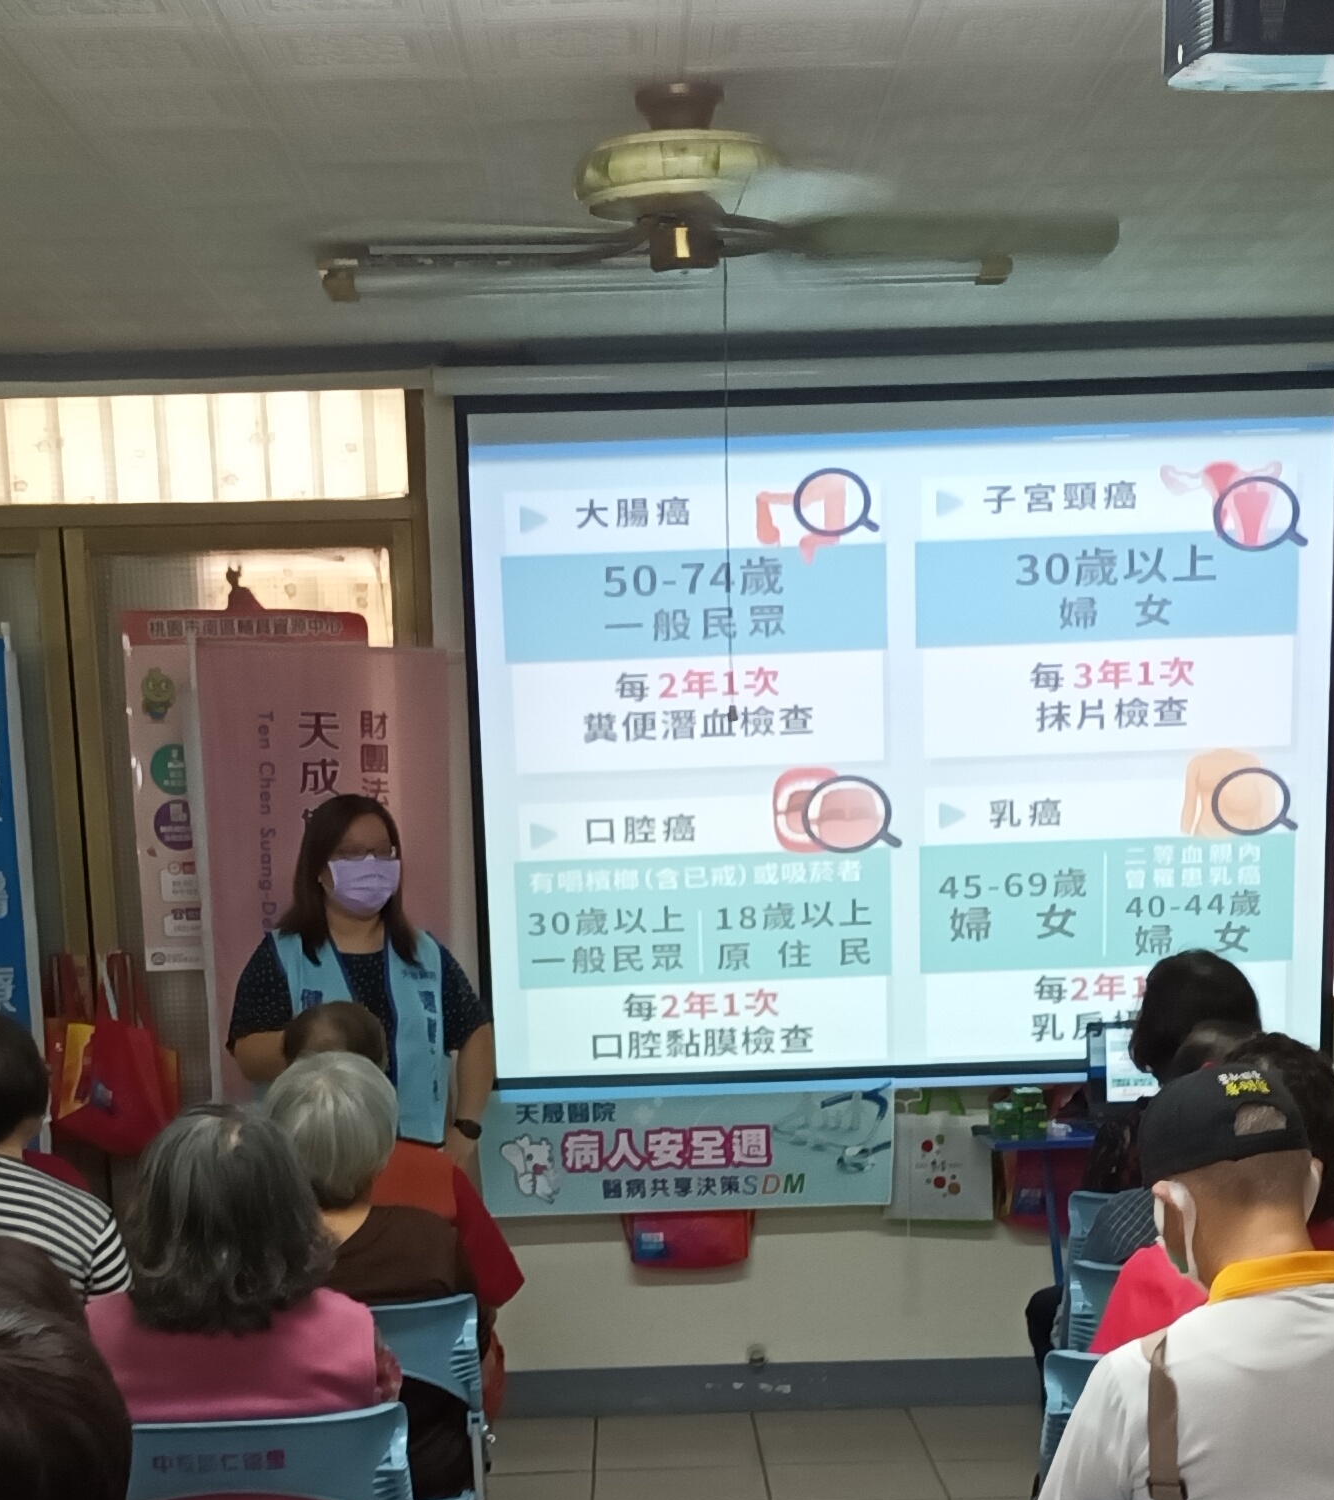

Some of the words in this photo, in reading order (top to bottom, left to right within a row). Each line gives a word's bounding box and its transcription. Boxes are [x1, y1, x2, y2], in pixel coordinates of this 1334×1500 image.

[575, 496, 690, 530] 大腸癌
[983, 480, 1137, 514] 子宮頸癌
[603, 556, 784, 599] 50-74歲
[1015, 544, 1217, 587] 30歲以上
[604, 604, 786, 642] 一般民眾
[615, 665, 779, 703] 每2年1次
[1029, 656, 1195, 693] 每3年1次
[258, 711, 274, 749] Ten
[583, 703, 815, 745] 糞便潛血檢查
[1036, 696, 1189, 733] 抹片檢查
[298, 711, 340, 823] 天成
[258, 761, 276, 815] Chen
[586, 813, 697, 845] 口腔癌
[989, 797, 1062, 828] 乳癌
[1124, 843, 1262, 866] 二等血親內
[938, 867, 1087, 900] 45-69歲
[1125, 865, 1262, 889] 曾罹患乳癌
[527, 904, 685, 937] 30歲以上
[715, 898, 873, 932] 18歲以上
[1125, 889, 1261, 919] 40-44歲
[531, 943, 685, 975] 一般民眾
[717, 937, 872, 972] 原住民
[623, 988, 780, 1022] 每2年1次
[592, 1024, 814, 1060] 口腔黏膜檢查
[516, 1102, 616, 1125] 天晟醫院
[563, 1126, 770, 1172] 病人安全週
